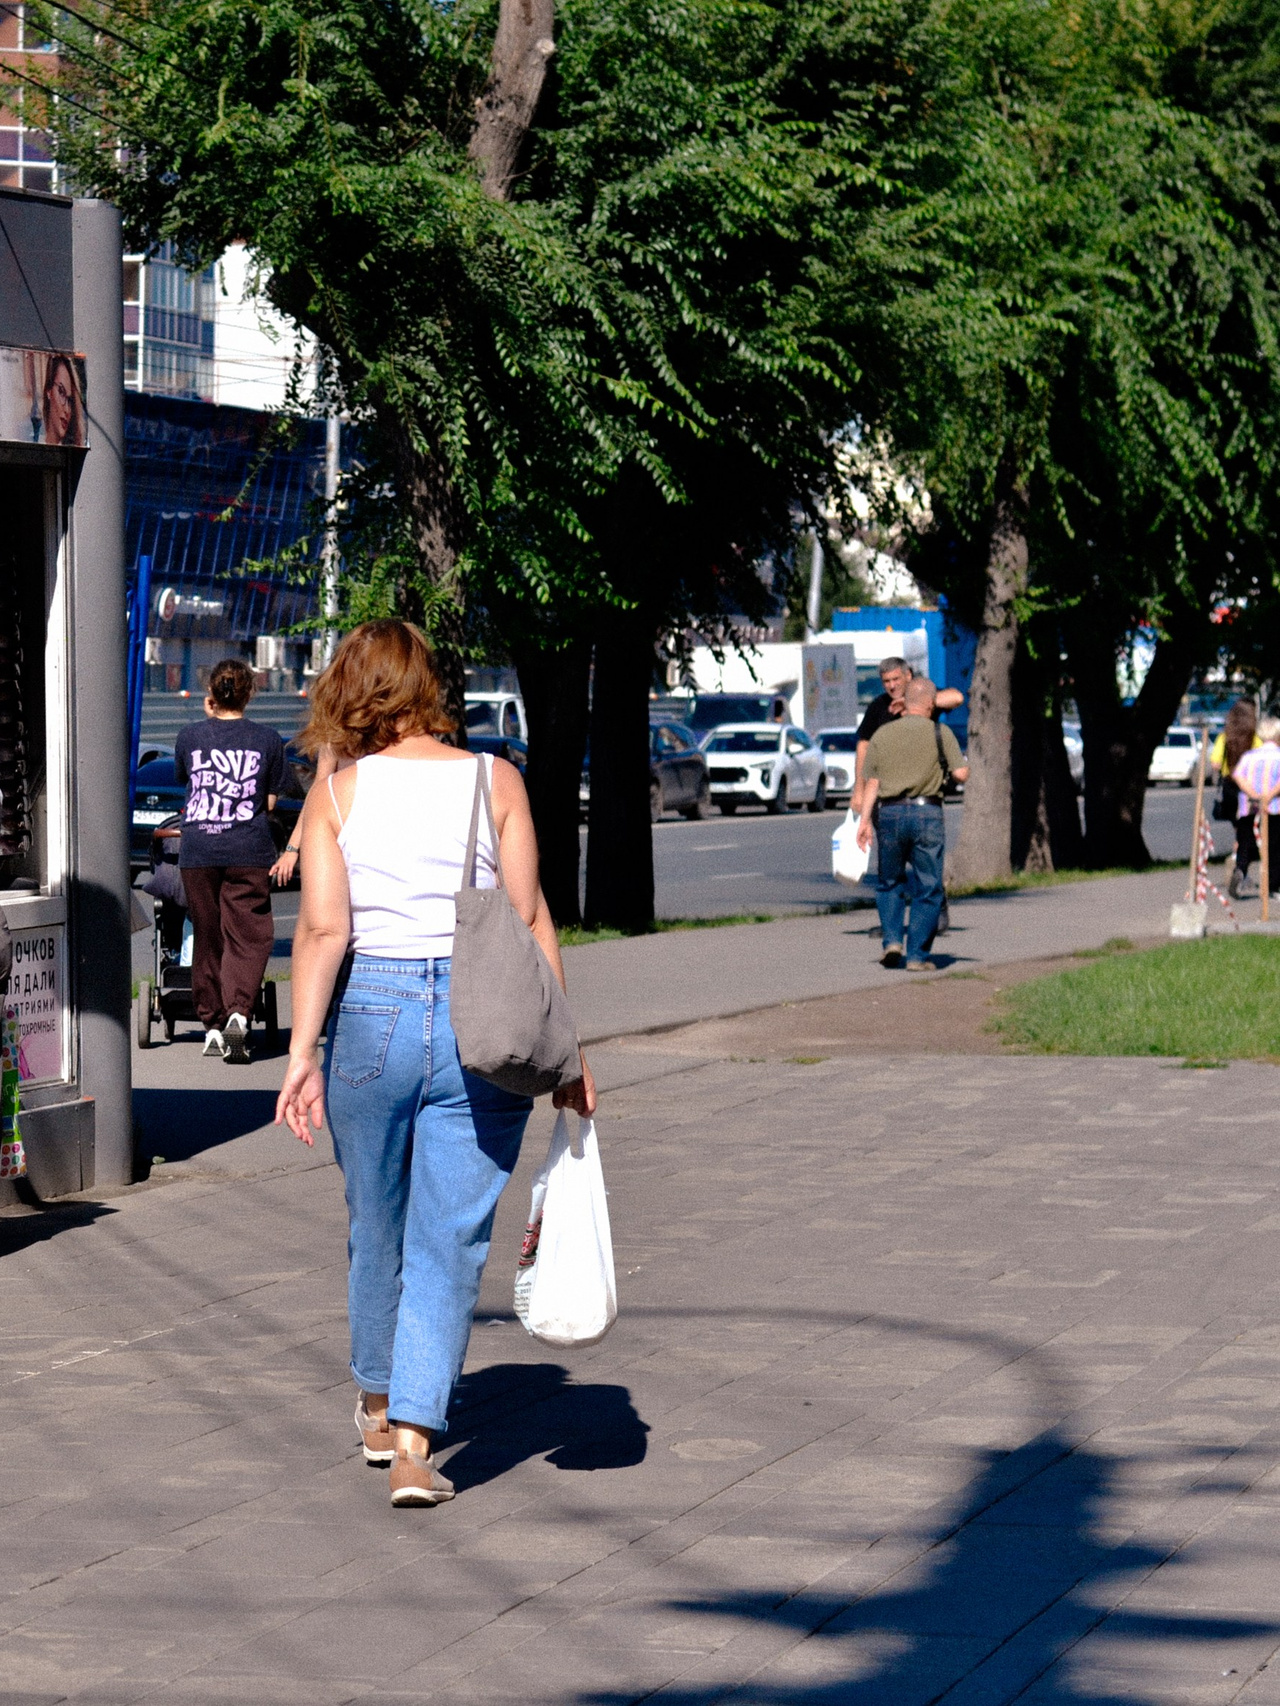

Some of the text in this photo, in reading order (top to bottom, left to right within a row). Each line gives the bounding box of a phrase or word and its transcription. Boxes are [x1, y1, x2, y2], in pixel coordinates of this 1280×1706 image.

[191, 749, 261, 781] LOVE
[190, 770, 257, 799] NEVER
[185, 788, 254, 822] FAILS
[15, 938, 55, 963] ОЧКОВ
[24, 970, 55, 997] ДАЛИ
